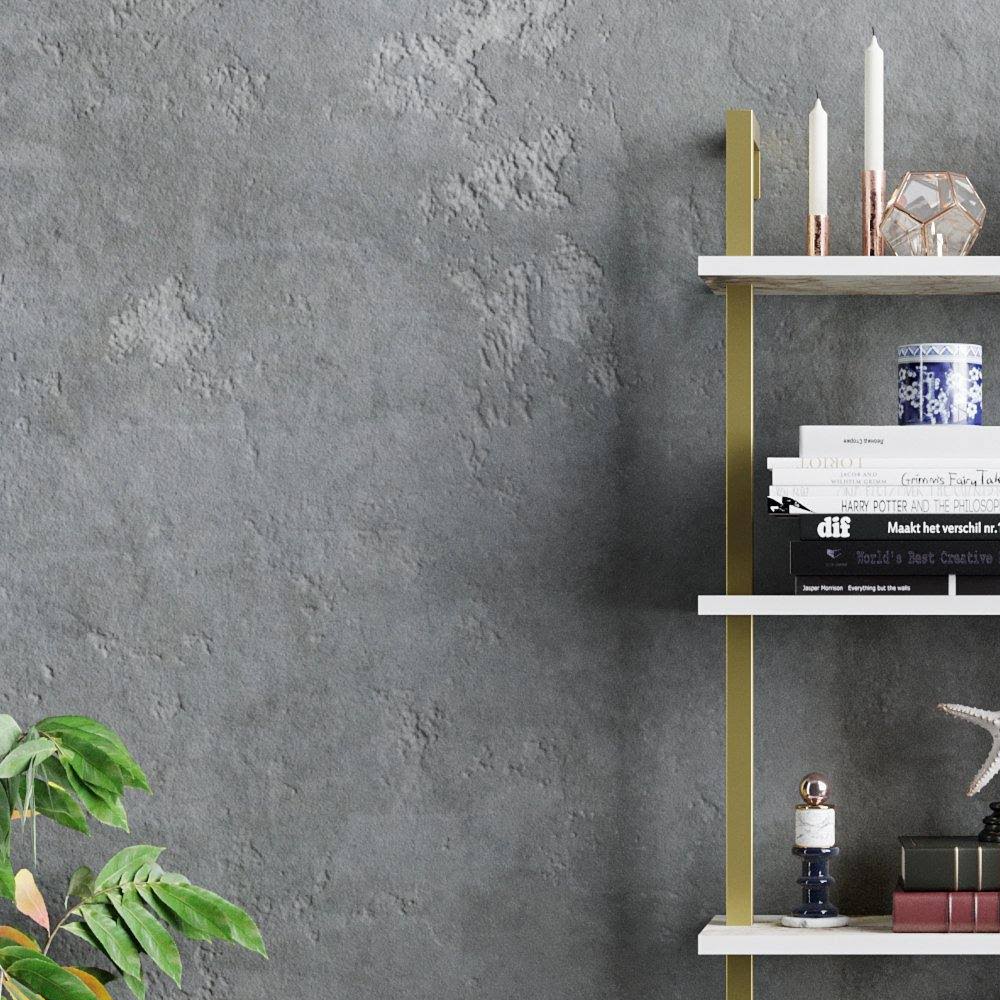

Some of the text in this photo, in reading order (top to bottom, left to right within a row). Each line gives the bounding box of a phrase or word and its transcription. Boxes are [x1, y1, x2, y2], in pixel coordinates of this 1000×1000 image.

[948, 472, 977, 487] Fairy
[841, 499, 869, 512] HARRY
[873, 499, 908, 512] POTTER
[911, 499, 930, 512] AND
[934, 499, 950, 512] THE
[817, 516, 852, 538] dif
[887, 521, 921, 534] Maakt
[922, 521, 941, 534] het
[942, 521, 982, 534] verschil
[857, 551, 902, 564] World's
[908, 551, 935, 565] Best
[940, 551, 993, 565] Creative
[848, 585, 876, 593] Everything
